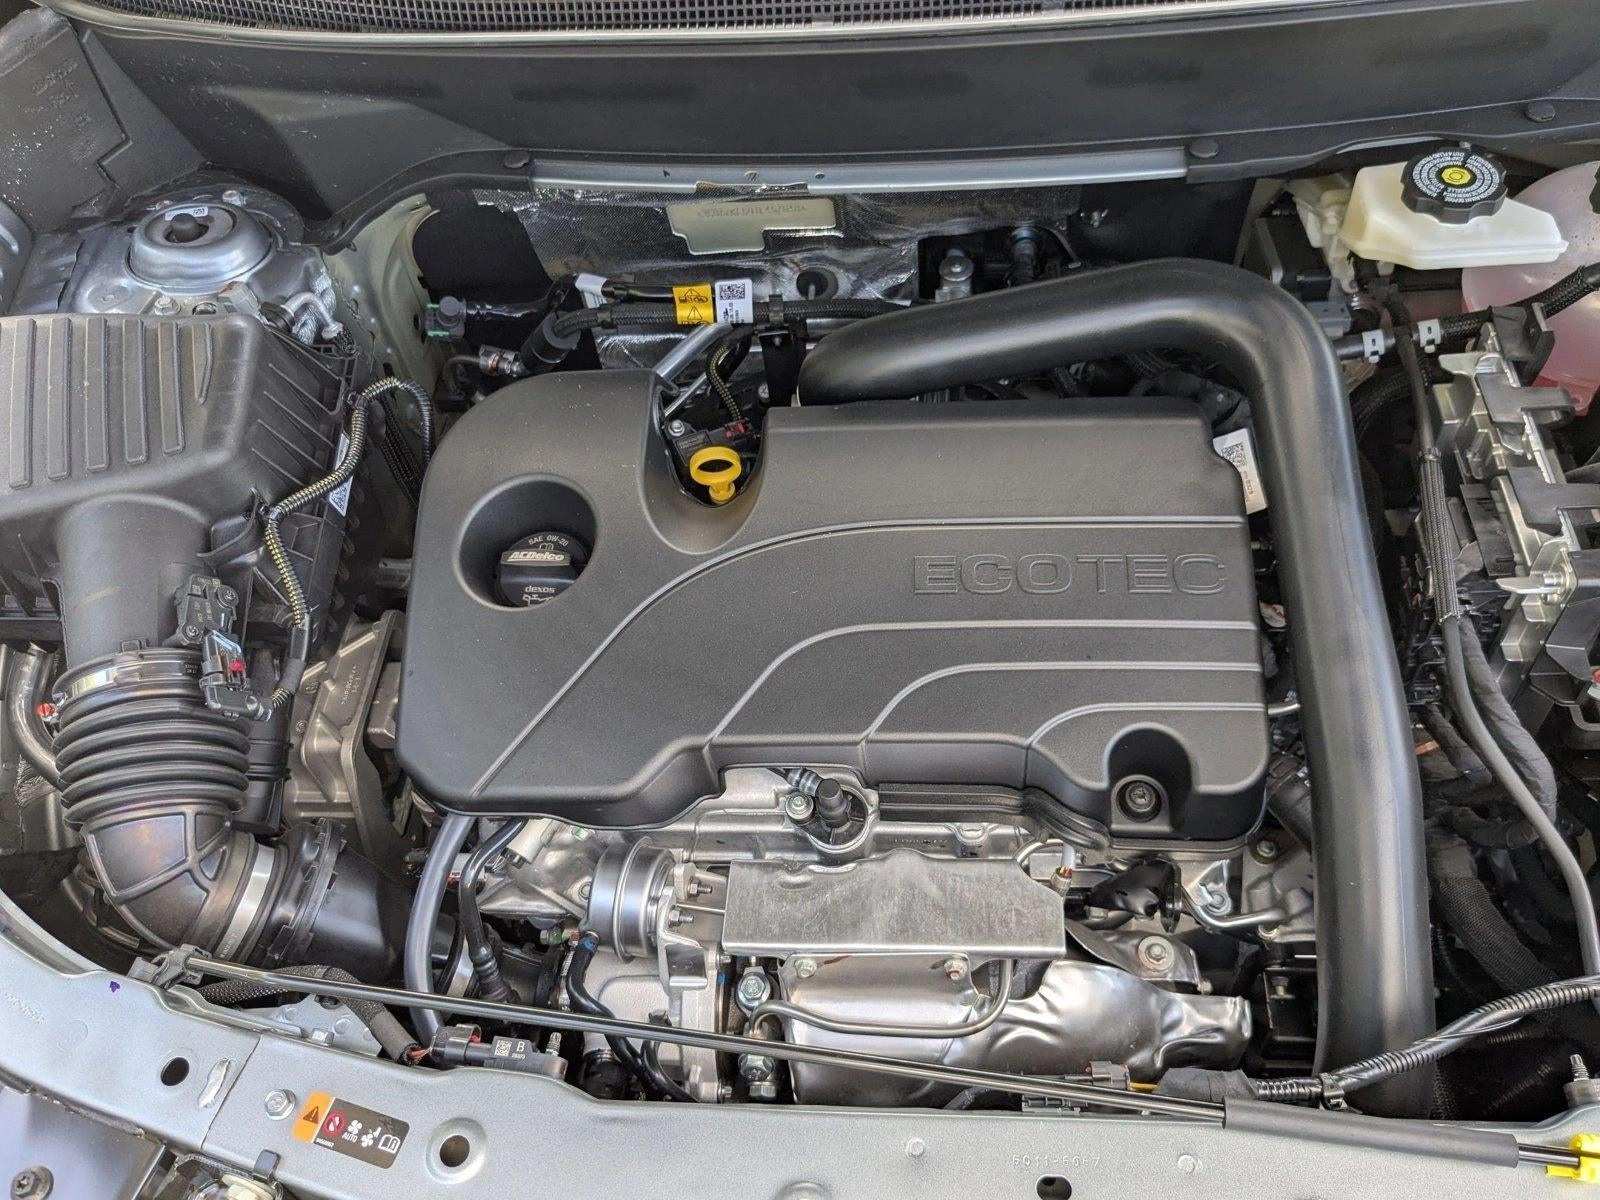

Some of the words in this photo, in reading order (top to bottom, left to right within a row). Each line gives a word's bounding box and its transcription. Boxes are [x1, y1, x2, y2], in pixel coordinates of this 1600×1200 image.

[528, 536, 543, 545] SAE
[546, 535, 569, 547] 0W-20
[506, 551, 565, 562] ACDelco
[913, 553, 1226, 595] ECOTEC
[525, 585, 556, 594] dexos
[516, 1041, 525, 1052] B
[342, 1132, 358, 1143] AUTO
